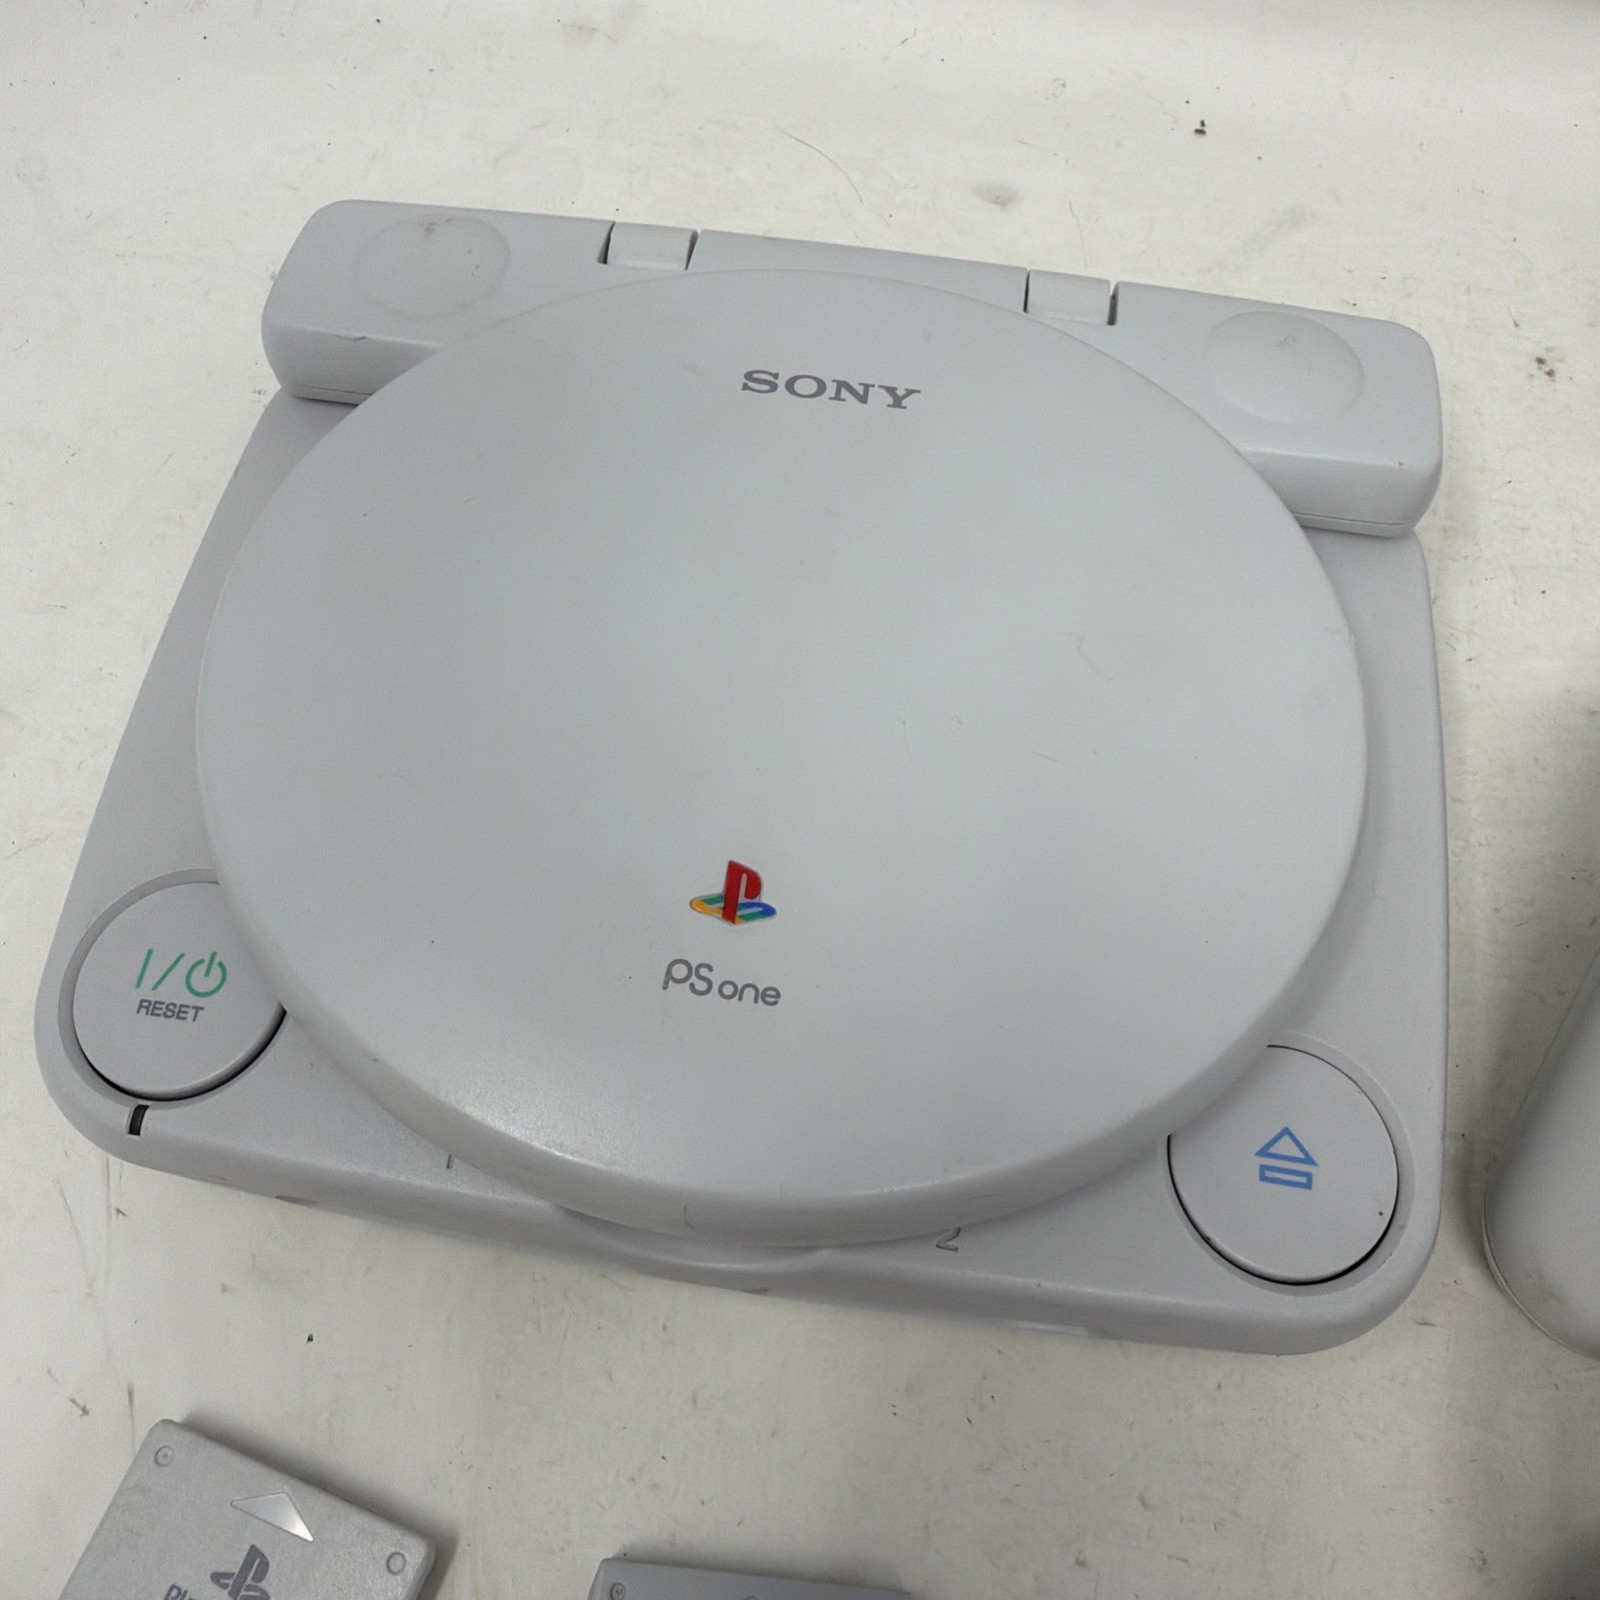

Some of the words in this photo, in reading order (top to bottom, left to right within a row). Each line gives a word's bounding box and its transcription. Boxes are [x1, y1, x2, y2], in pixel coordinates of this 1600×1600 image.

[741, 369, 921, 410] SONY
[662, 958, 714, 996] PS
[717, 980, 781, 1006] one
[136, 999, 204, 1022] RESET
